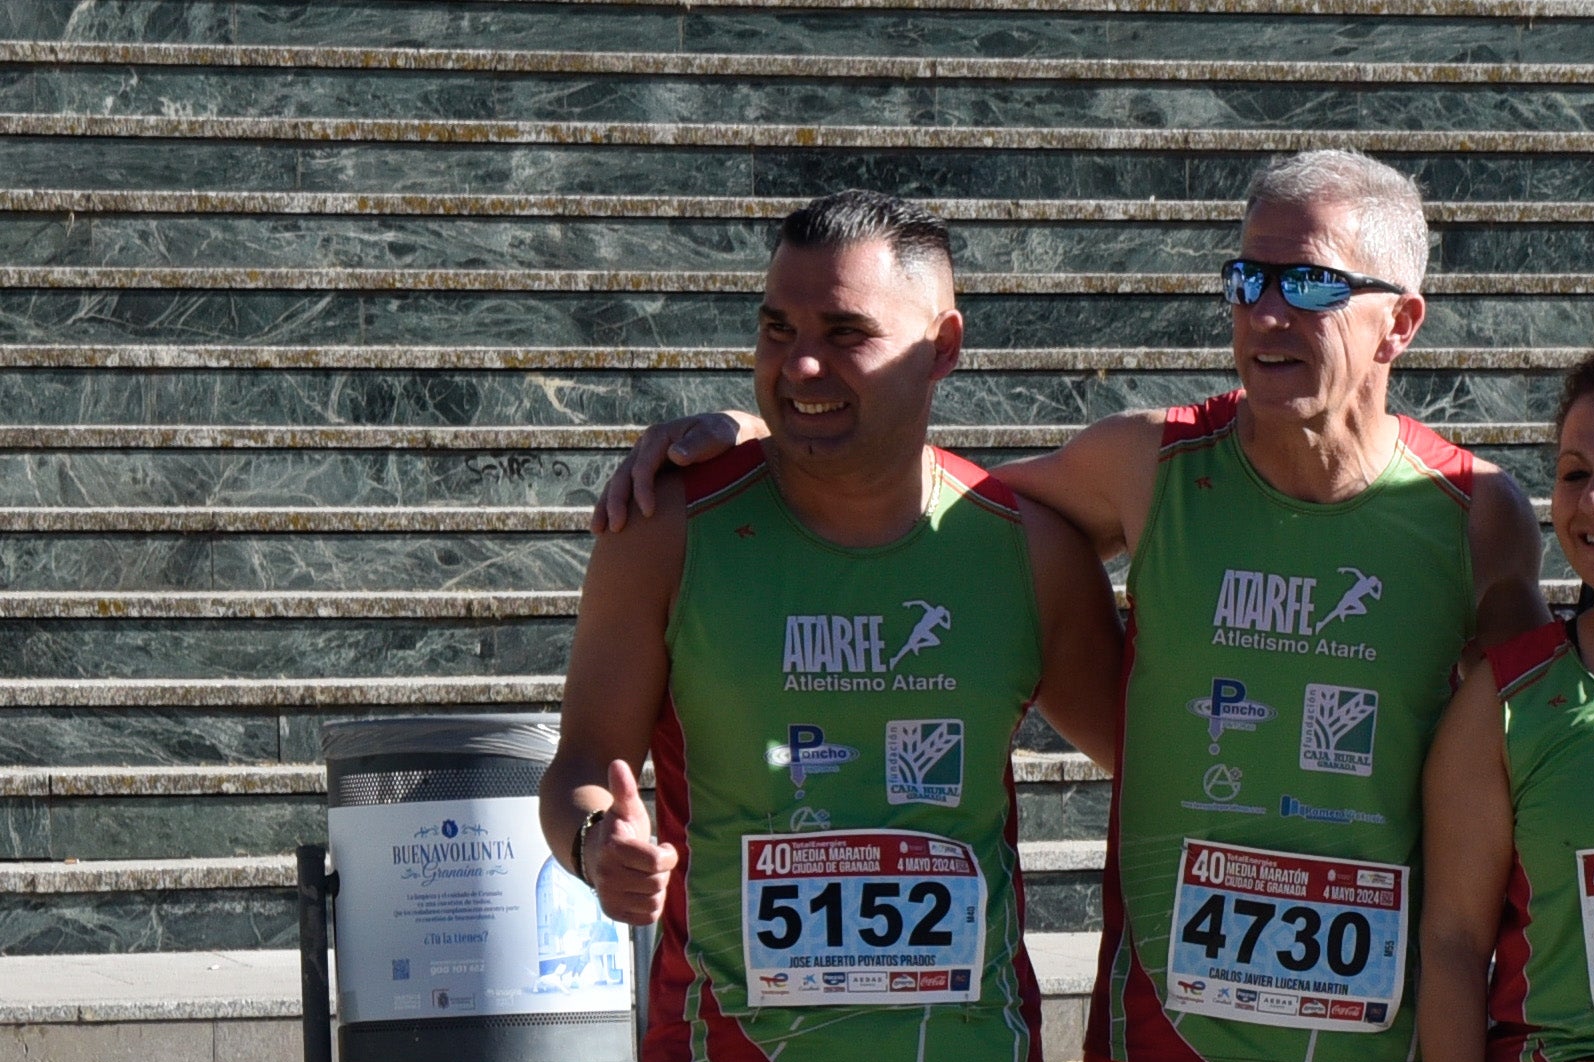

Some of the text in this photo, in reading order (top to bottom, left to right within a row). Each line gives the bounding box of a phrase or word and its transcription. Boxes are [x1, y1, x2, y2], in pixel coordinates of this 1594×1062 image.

[1213, 569, 1317, 636] ATARFE
[783, 615, 886, 673] ATARFE
[1212, 629, 1377, 660] Atletismo Atarfe
[784, 674, 957, 692] Atletismo Atarfe
[1211, 678, 1265, 718] Poncho
[790, 724, 847, 762] Poncho
[1304, 751, 1371, 766] CAJA RURAL
[891, 785, 959, 796] CAJA RURAL
[393, 837, 514, 865] BUENAVOLUNTÁ
[756, 843, 791, 875] 40
[793, 844, 880, 862] MEDIA MARATÓN
[792, 861, 880, 874] CIUDAD DE GRANADA
[897, 858, 955, 872] 4 MAYO 2024
[1192, 849, 1225, 884] 40
[1226, 862, 1309, 885] MEDIA MARATÓN
[1225, 876, 1306, 896] CIUDAD DE GRANADA
[1323, 886, 1380, 904] 4 MAYO 2024
[757, 881, 952, 949] 5152
[443, 932, 452, 944] la
[454, 930, 488, 944] tienes?
[1182, 894, 1370, 977] 4730
[789, 955, 935, 968] JOSE ALBERTO POYATOS PRADOS
[1209, 967, 1348, 995] CARLOS JAVIER LUCENA MARTIN
